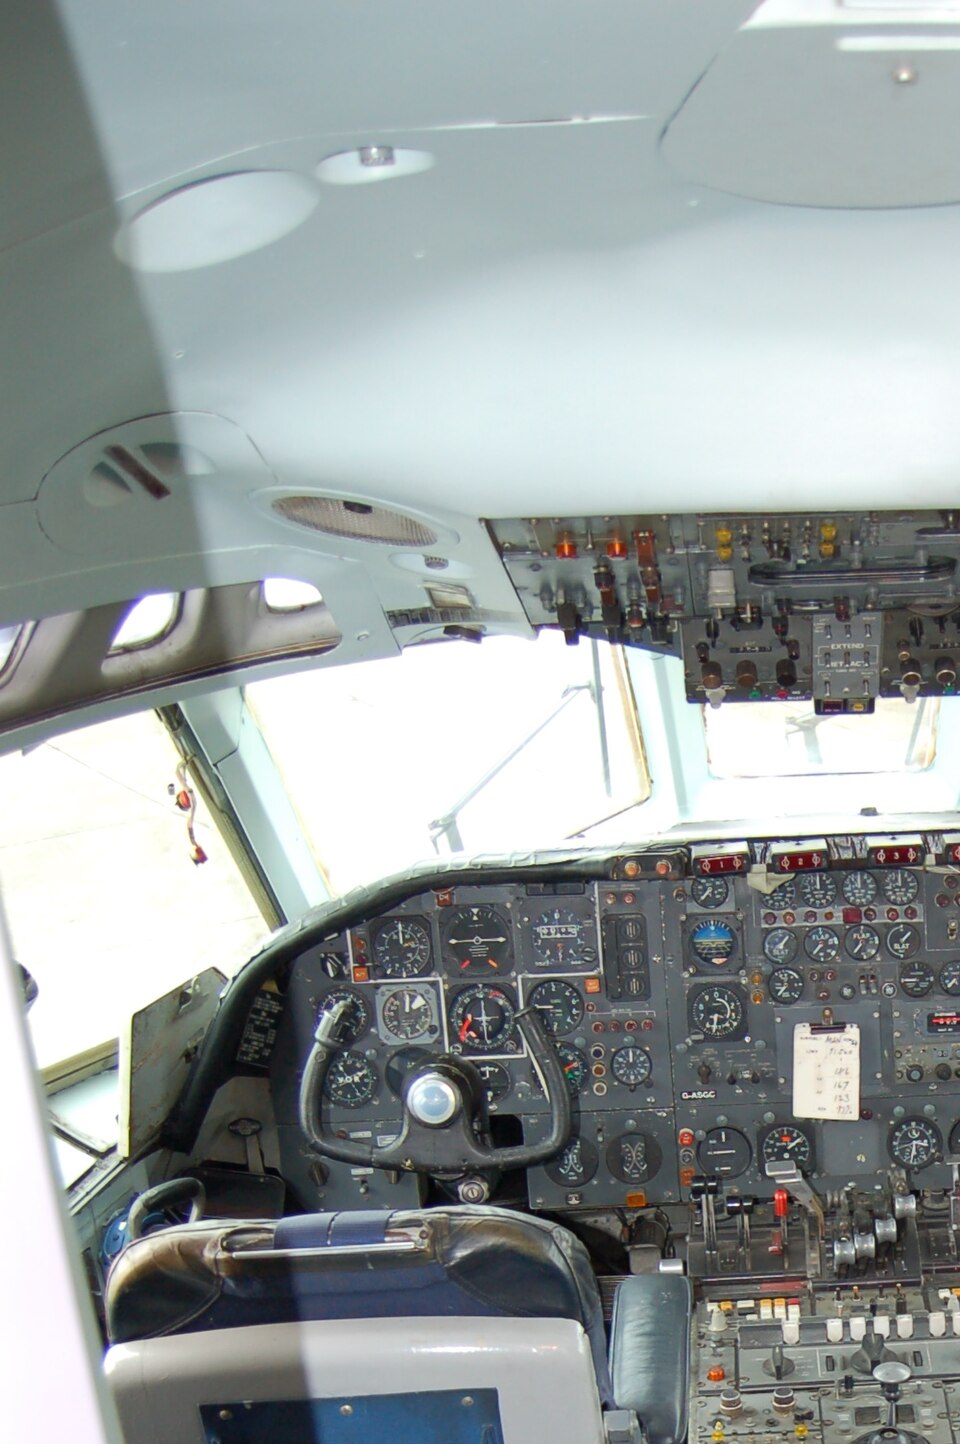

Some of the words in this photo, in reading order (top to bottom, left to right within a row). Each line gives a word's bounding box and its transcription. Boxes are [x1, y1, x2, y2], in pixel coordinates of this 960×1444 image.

[893, 852, 900, 860] 3
[797, 858, 804, 866] 2
[681, 1090, 716, 1100] G-ASGC
